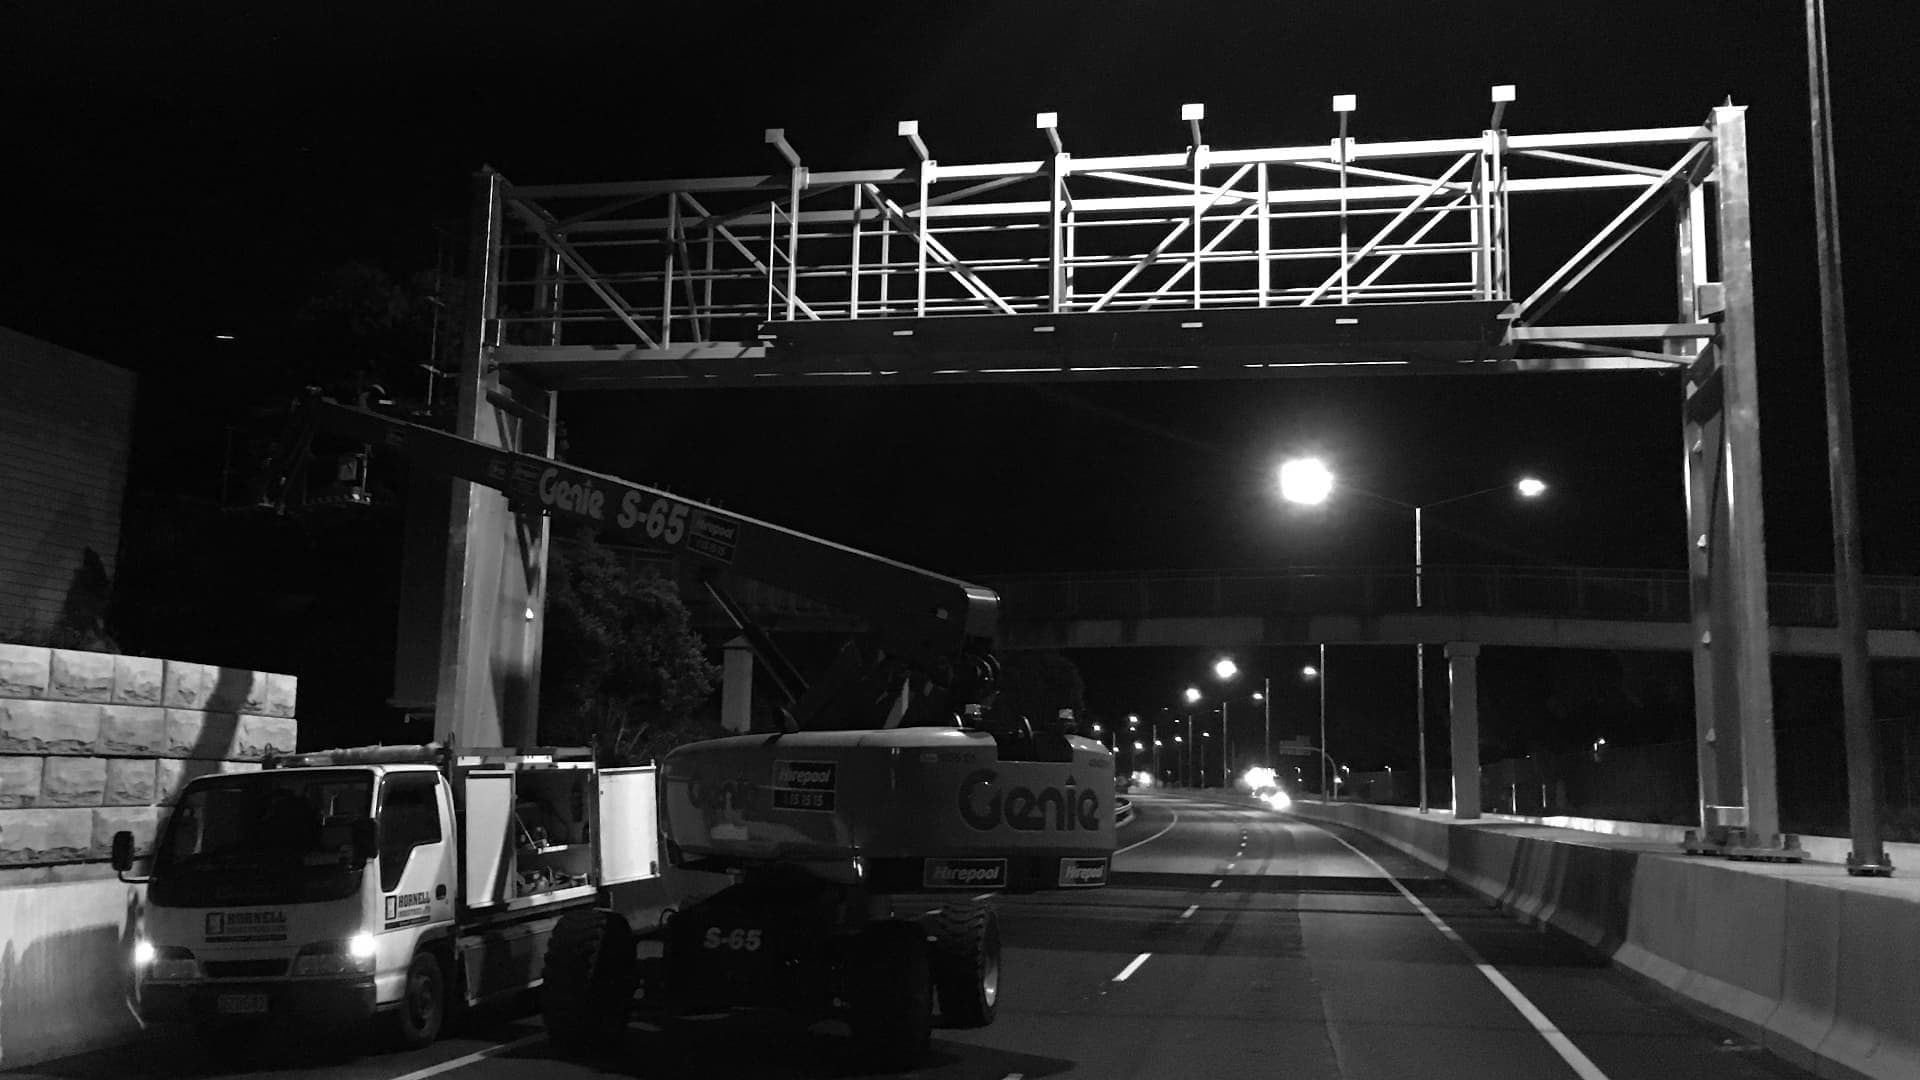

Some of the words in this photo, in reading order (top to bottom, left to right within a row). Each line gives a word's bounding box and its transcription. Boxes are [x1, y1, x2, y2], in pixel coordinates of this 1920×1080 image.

[539, 468, 604, 520] Genie
[616, 489, 690, 545] S-65
[778, 768, 832, 786] Hirepool
[957, 767, 1100, 832] Genie
[933, 865, 1000, 884] Hirepool
[1065, 864, 1105, 882] Hirepool
[703, 926, 763, 951] S-65
